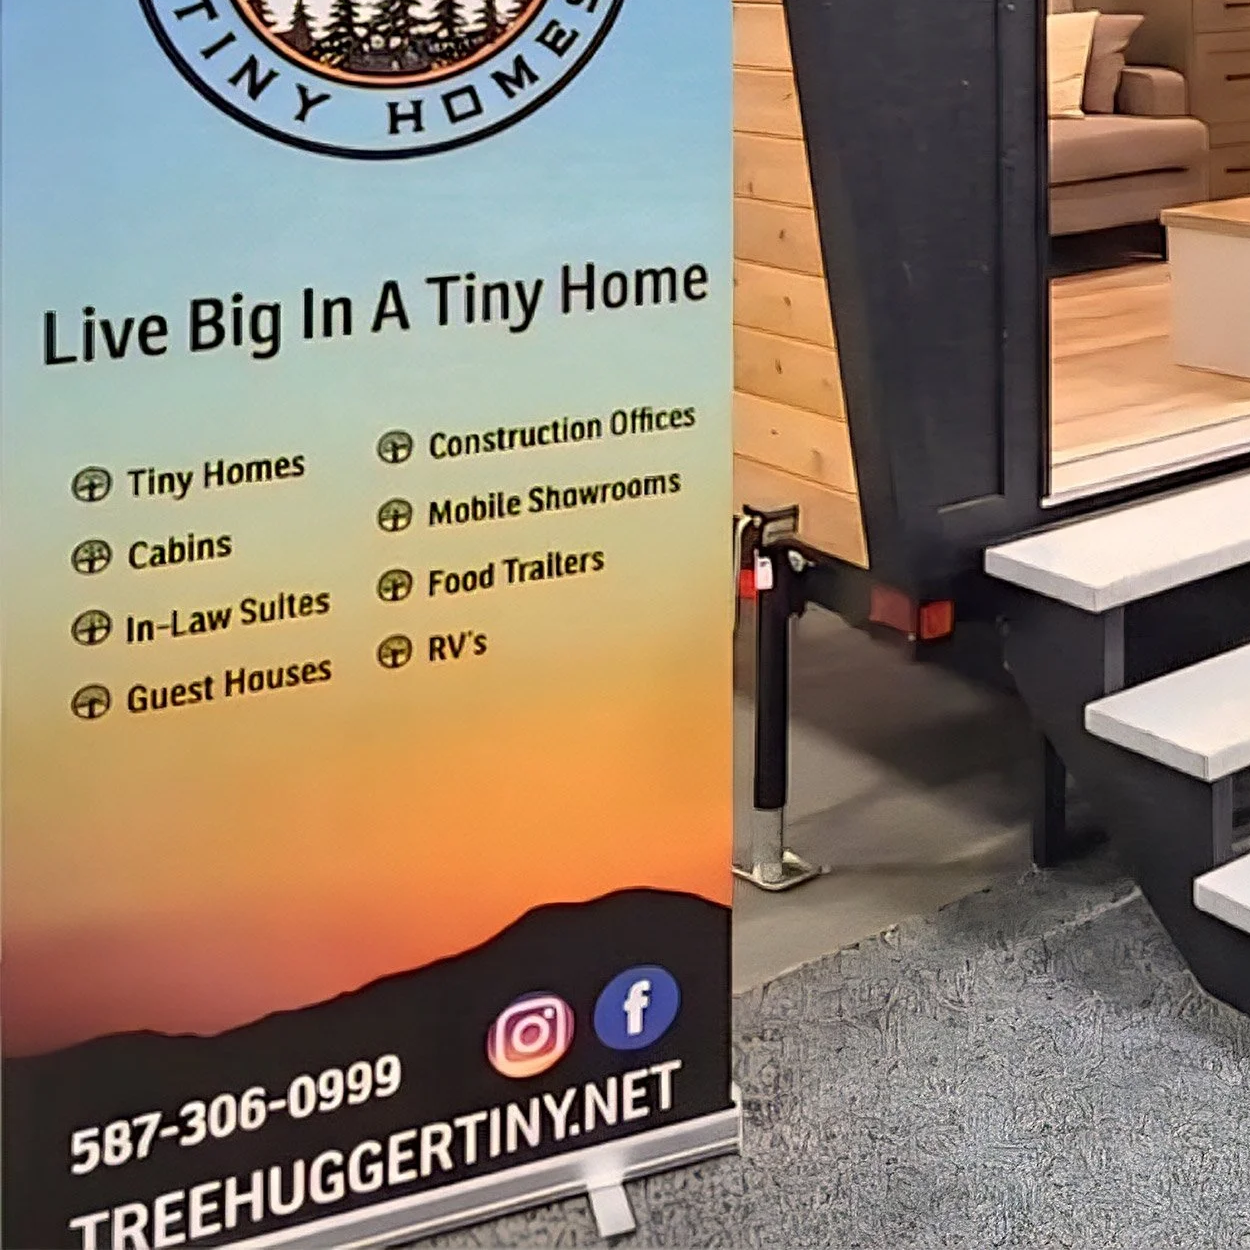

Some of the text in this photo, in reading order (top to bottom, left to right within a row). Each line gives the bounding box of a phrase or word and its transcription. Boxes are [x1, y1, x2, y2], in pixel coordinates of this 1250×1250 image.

[44, 262, 708, 366] Live Big In A Tiny Home
[429, 406, 696, 460] Construction Offices
[127, 455, 305, 501] Tiny Homes
[428, 472, 681, 526] Mobile Showrooms
[128, 532, 232, 570] Cabins
[428, 551, 605, 597] Food Trailers
[126, 592, 330, 644] In-Law Suites
[429, 630, 487, 662] RV's
[127, 659, 332, 714] Guest Houses
[72, 1055, 401, 1174] 587-306-0999
[69, 1060, 681, 1250] TREEHUGGERTINY.NET
